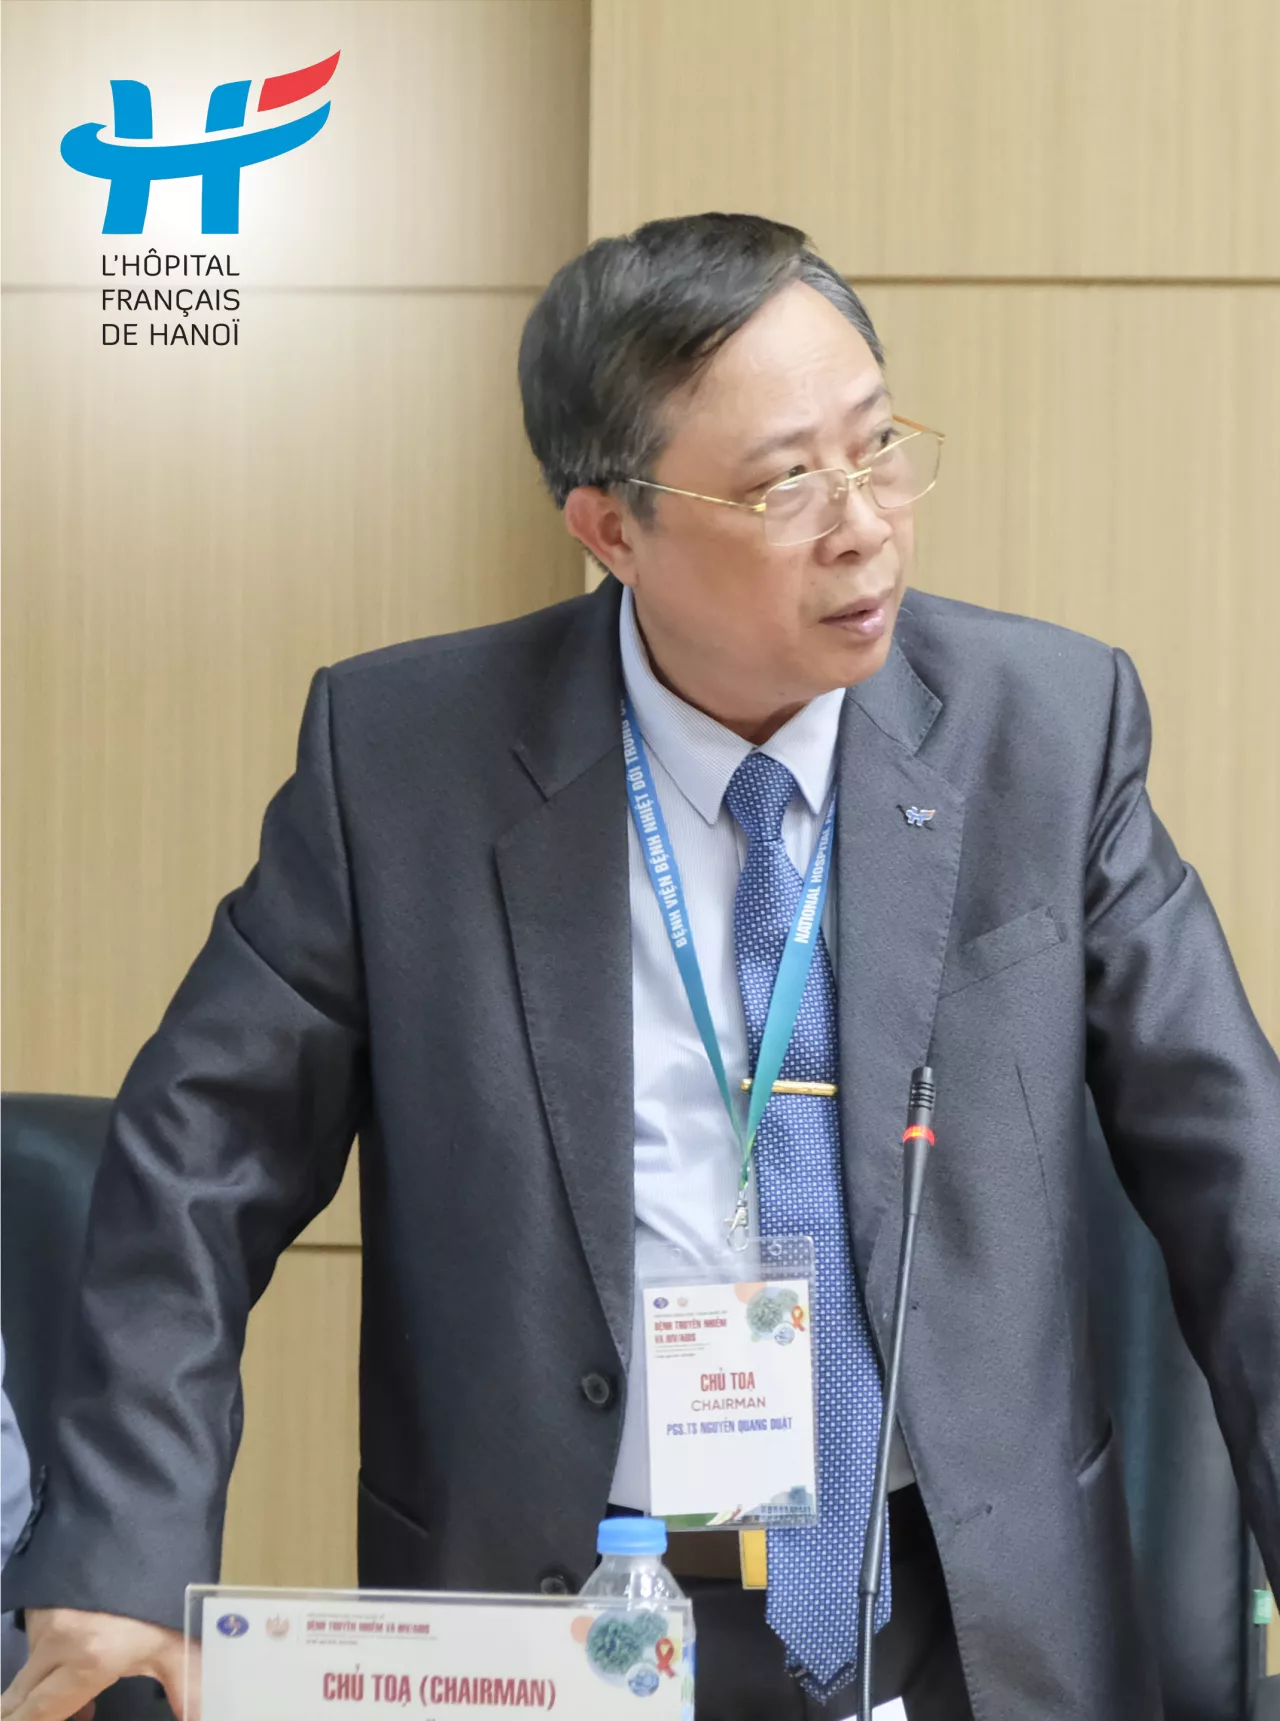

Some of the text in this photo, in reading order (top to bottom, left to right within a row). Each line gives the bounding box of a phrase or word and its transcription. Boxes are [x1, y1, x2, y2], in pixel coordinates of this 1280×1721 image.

[647, 834, 670, 874] BỆNH
[657, 874, 680, 908] VIỆN
[794, 885, 821, 944] NATIONAL
[810, 826, 832, 884] HOSPITAL
[669, 908, 689, 949] BỆNH
[700, 1367, 726, 1392] CHỦ
[691, 1396, 767, 1412] CHAIRMAN
[322, 1664, 365, 1702] CHỦ
[419, 1674, 557, 1711] (CHAIRMAN)
